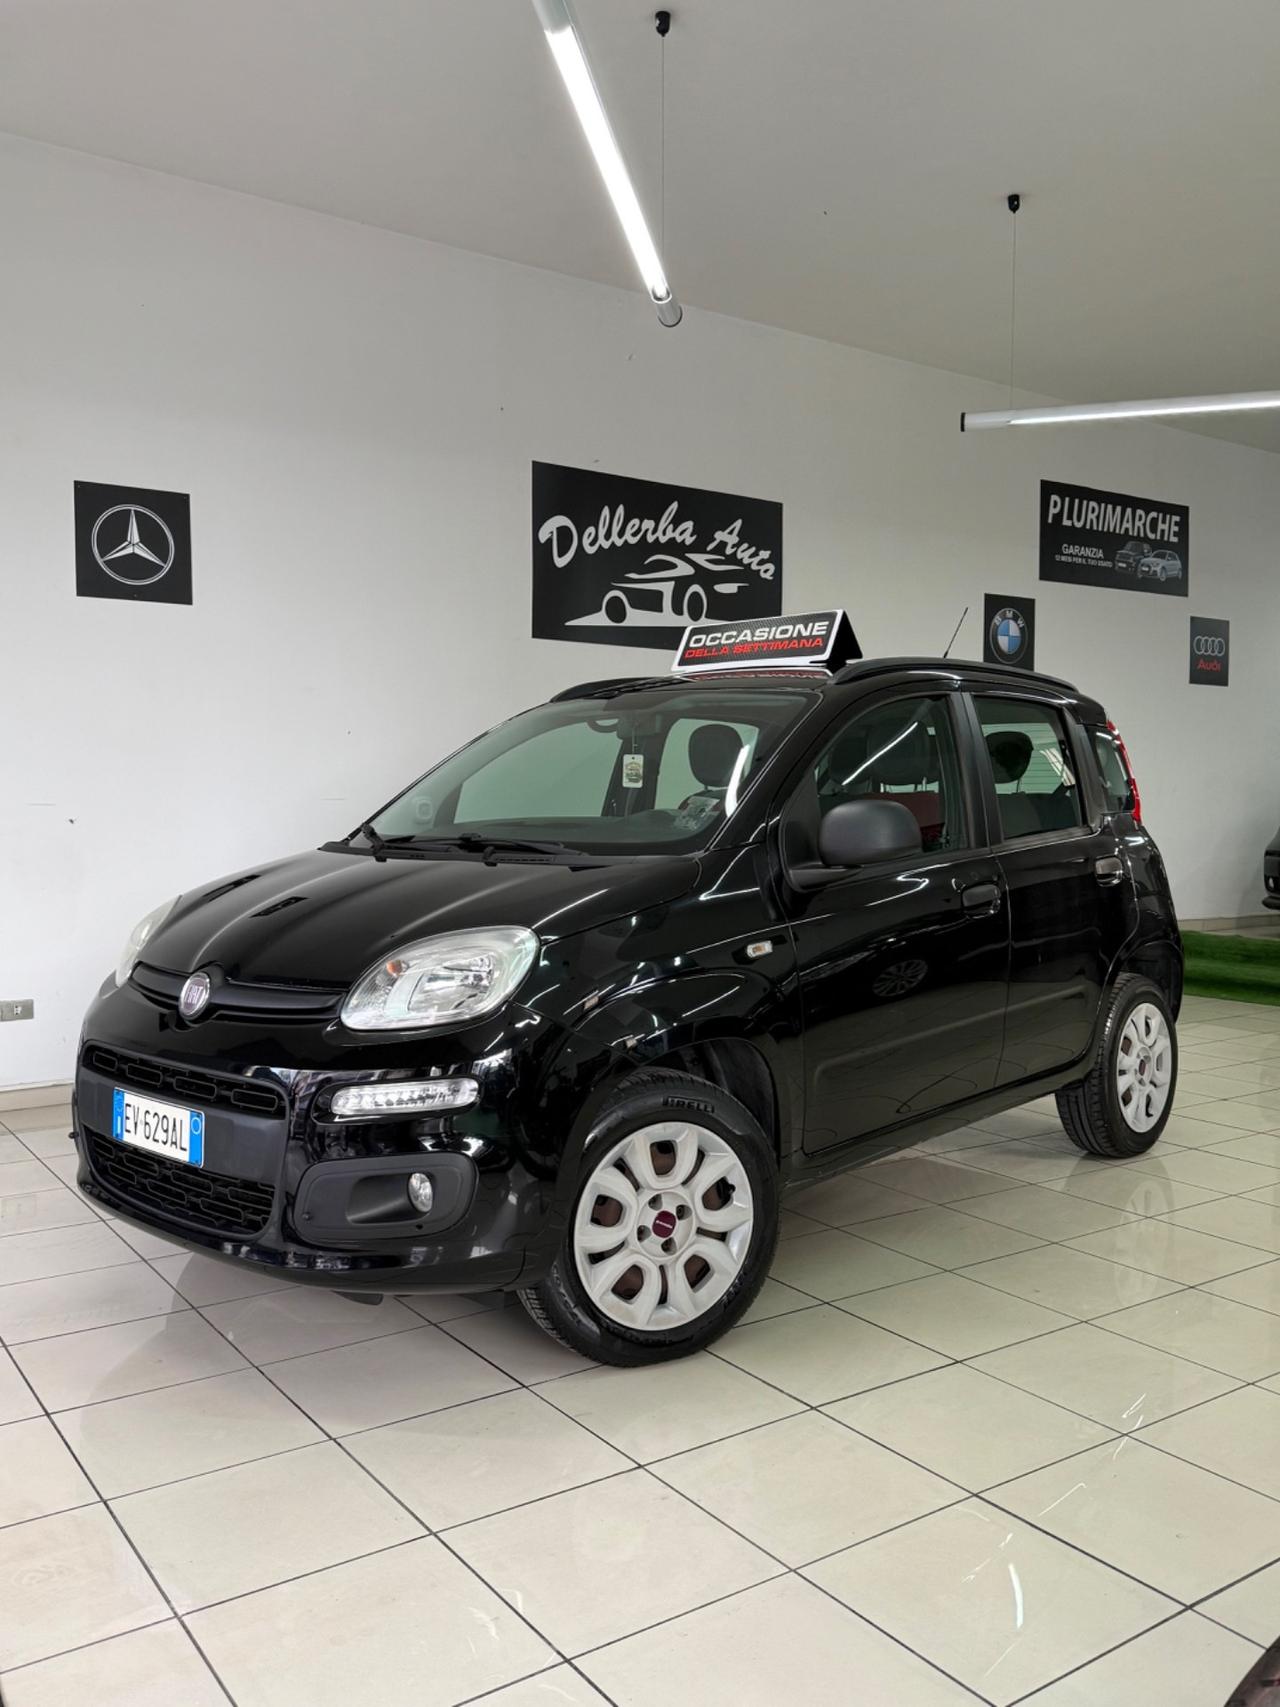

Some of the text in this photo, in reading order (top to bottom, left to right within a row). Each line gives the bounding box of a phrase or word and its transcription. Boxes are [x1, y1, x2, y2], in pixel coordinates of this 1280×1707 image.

[1048, 494, 1181, 543] PLURIMARCHE
[538, 501, 775, 580] Dellerba Auto
[1062, 543, 1105, 559] GARANZIA
[994, 610, 1025, 628] BMW
[689, 621, 830, 648] OCCASIONE
[684, 637, 824, 660] DELLA SETTIMANA
[1197, 658, 1222, 672] Audi
[662, 1095, 715, 1114] PIRELLI
[124, 1103, 188, 1152] EV 629AL
